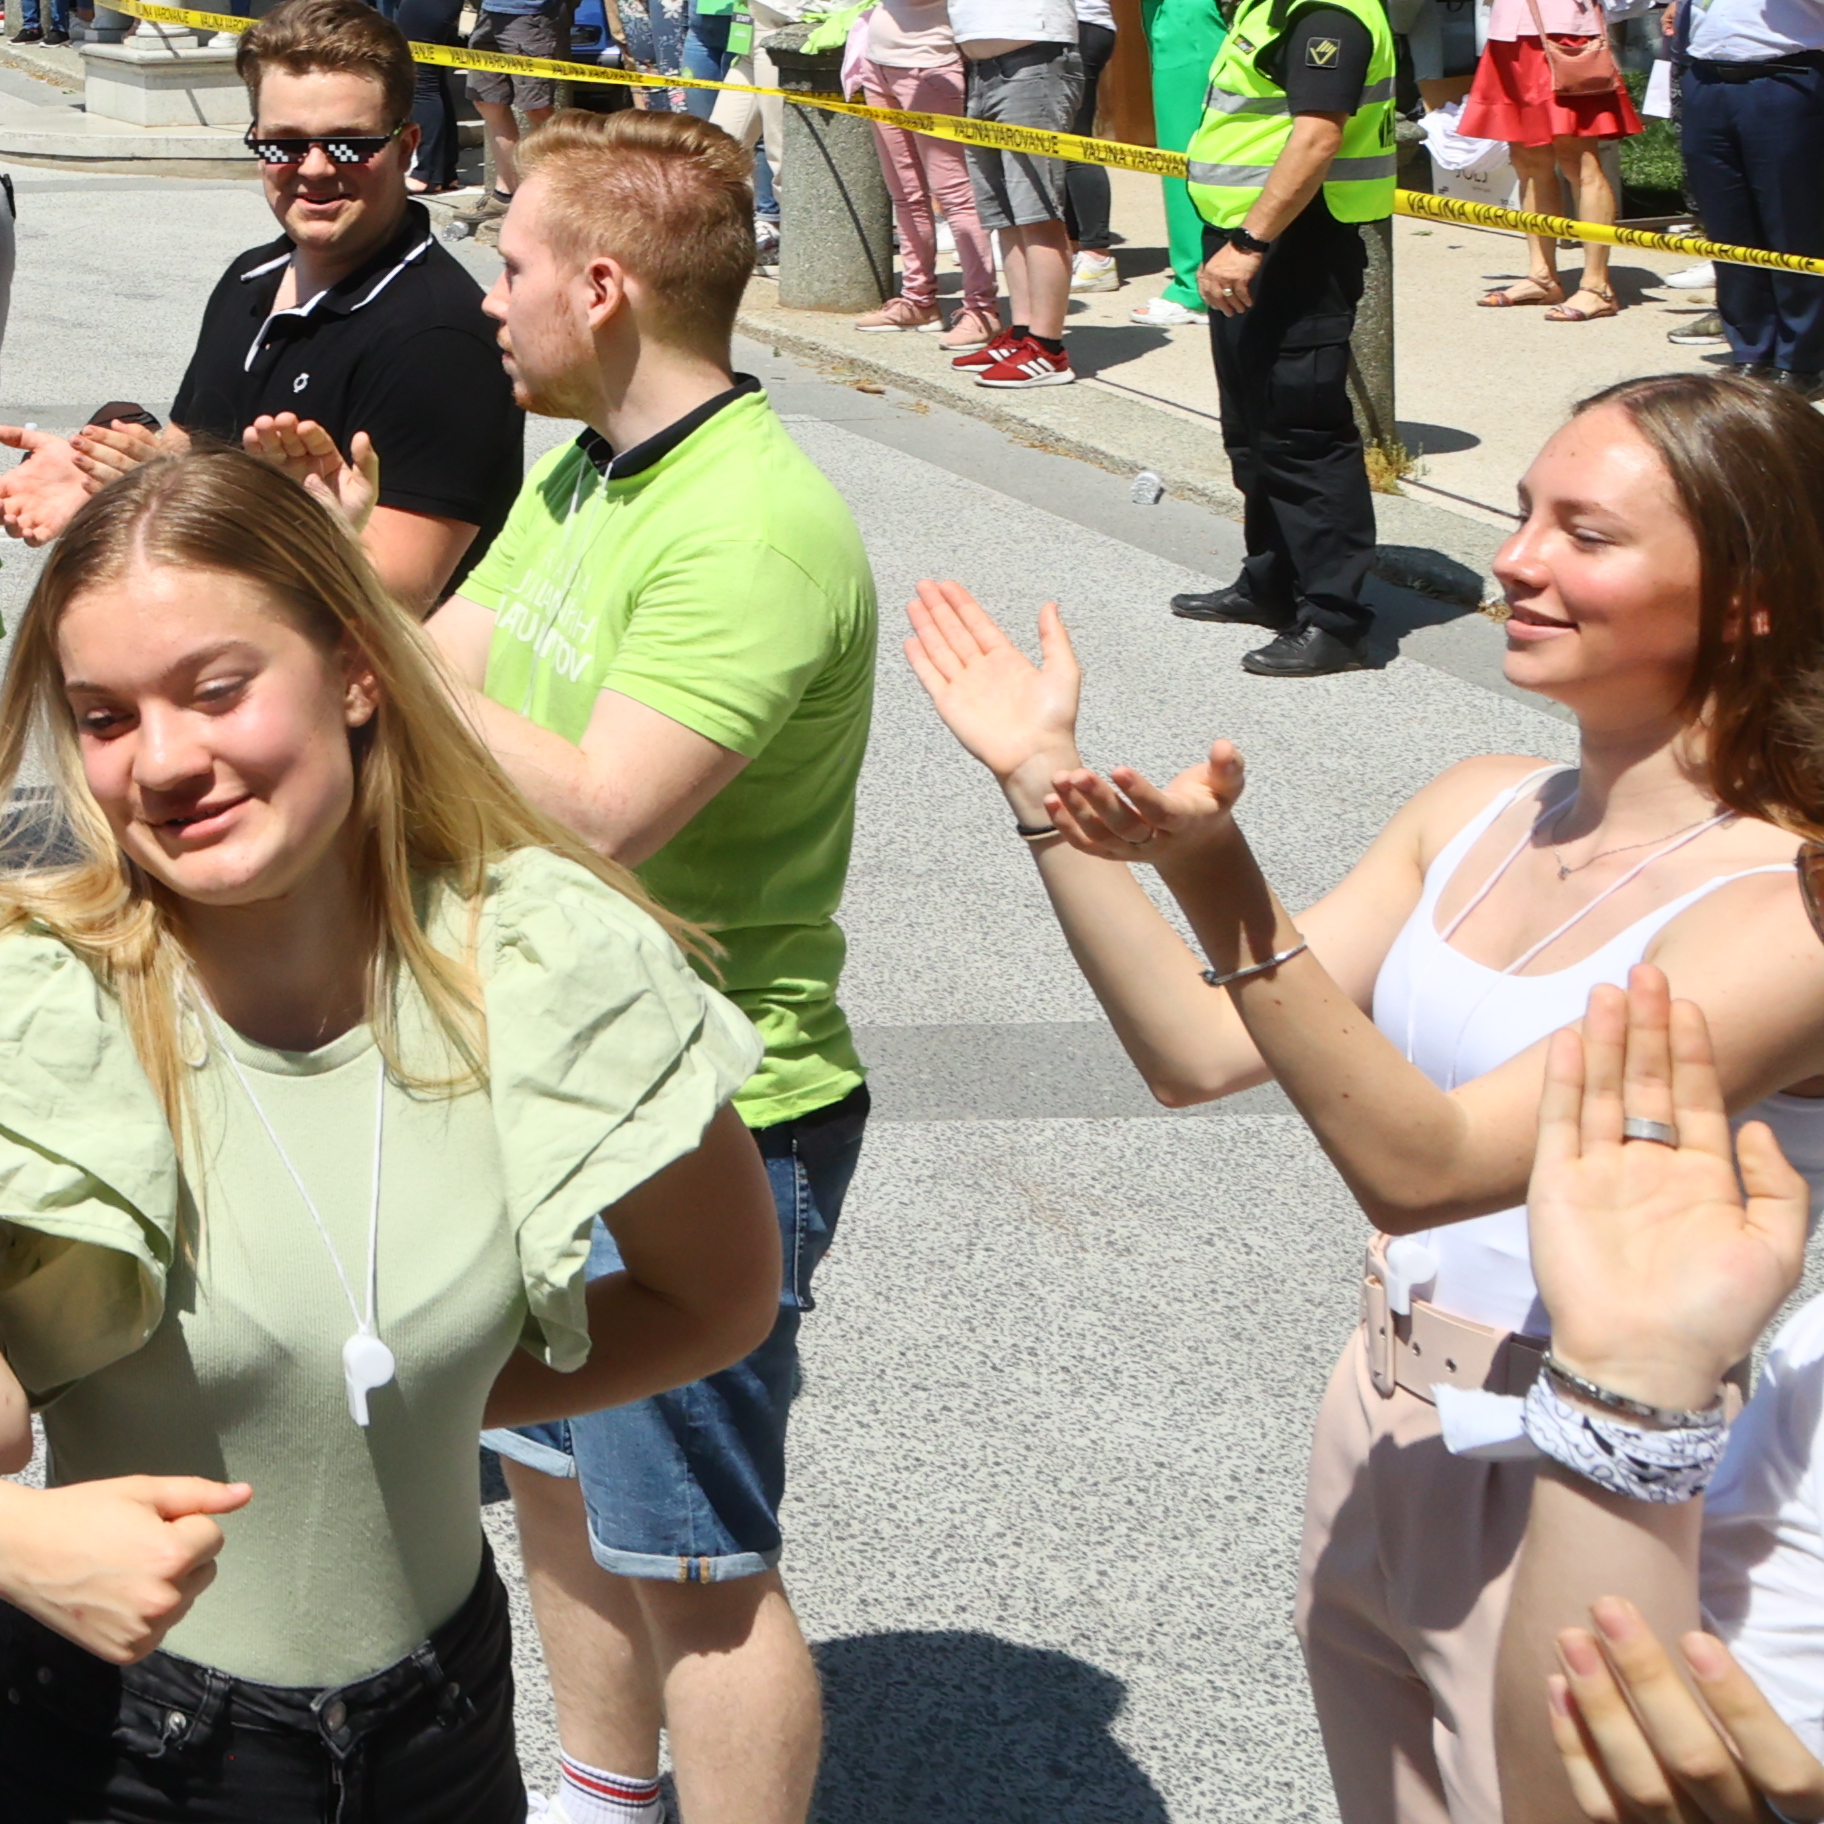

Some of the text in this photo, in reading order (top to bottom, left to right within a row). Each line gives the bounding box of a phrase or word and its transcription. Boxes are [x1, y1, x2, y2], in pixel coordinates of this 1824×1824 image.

[951, 118, 1060, 154] VALINA VAROVANJE
[1407, 192, 1580, 238] VALINA VAROVANJE
